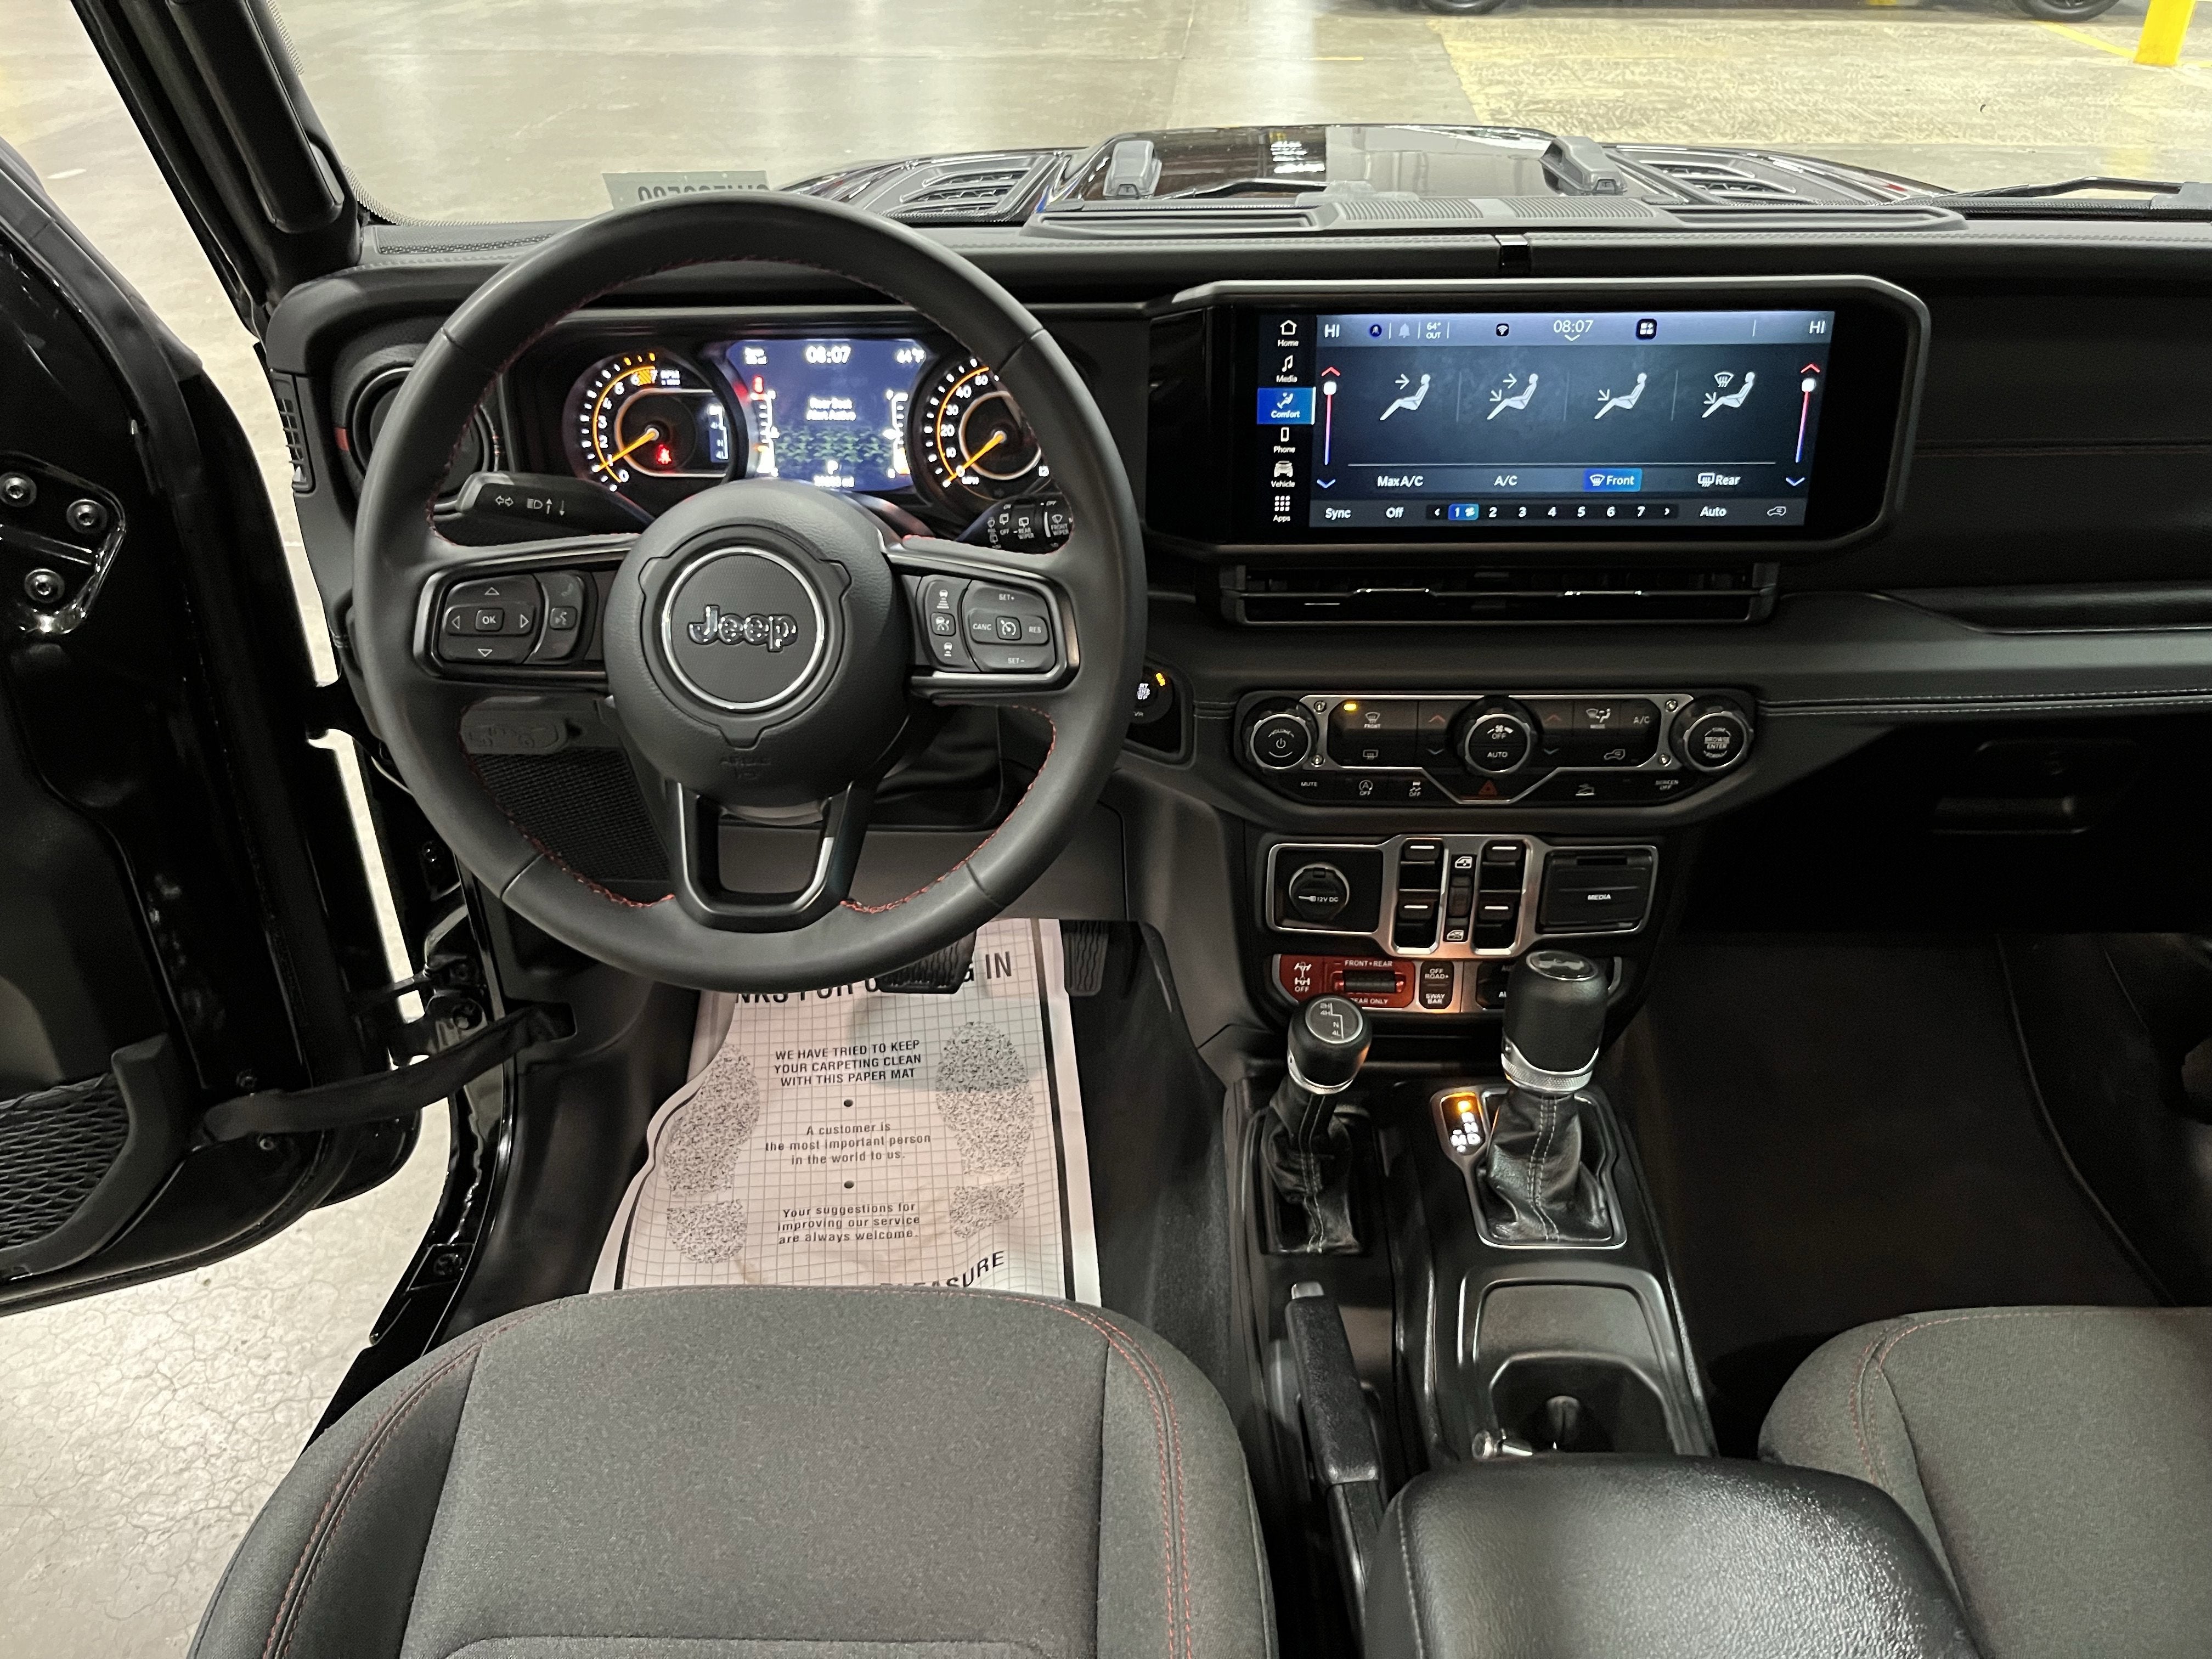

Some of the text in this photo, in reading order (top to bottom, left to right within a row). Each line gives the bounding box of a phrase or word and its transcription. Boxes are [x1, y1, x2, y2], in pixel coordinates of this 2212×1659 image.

[1324, 324, 1340, 338] HI
[1553, 320, 1594, 333] 08:07
[1809, 321, 1826, 334] HI
[806, 346, 851, 364] 08:07
[1276, 375, 1297, 383] Media
[956, 385, 972, 398] 40
[946, 404, 959, 416] 30
[1271, 410, 1300, 419] Comfort
[940, 424, 955, 437] 20
[599, 435, 608, 448] 2
[618, 470, 629, 482] 0
[1494, 475, 1518, 487] A/C
[1606, 475, 1635, 486] Front
[1715, 475, 1741, 486] Rear
[1325, 508, 1351, 520] Sync
[1386, 507, 1404, 518] Off
[1454, 507, 1645, 517] 1 2 3 4 5 6 7
[1700, 506, 1727, 517] Auto
[1273, 515, 1290, 523] Apps
[482, 616, 496, 624] OK
[688, 605, 799, 652] Jeep
[1633, 716, 1650, 724] A/C
[986, 951, 1012, 979] IN
[776, 1040, 920, 1060] WE HAVE TRIED TO KEEP
[775, 1054, 921, 1074] YOUR CARPETING CLEAN
[781, 1068, 915, 1086] WITH THIS PAPER MAT
[806, 1121, 891, 1135] A customer is
[765, 1135, 931, 1151] the most important person
[792, 1150, 905, 1165] in the world to us.
[783, 1202, 915, 1218] Your suggestions for
[778, 1216, 920, 1232] improving our service
[779, 1229, 918, 1244] are always welcome.
